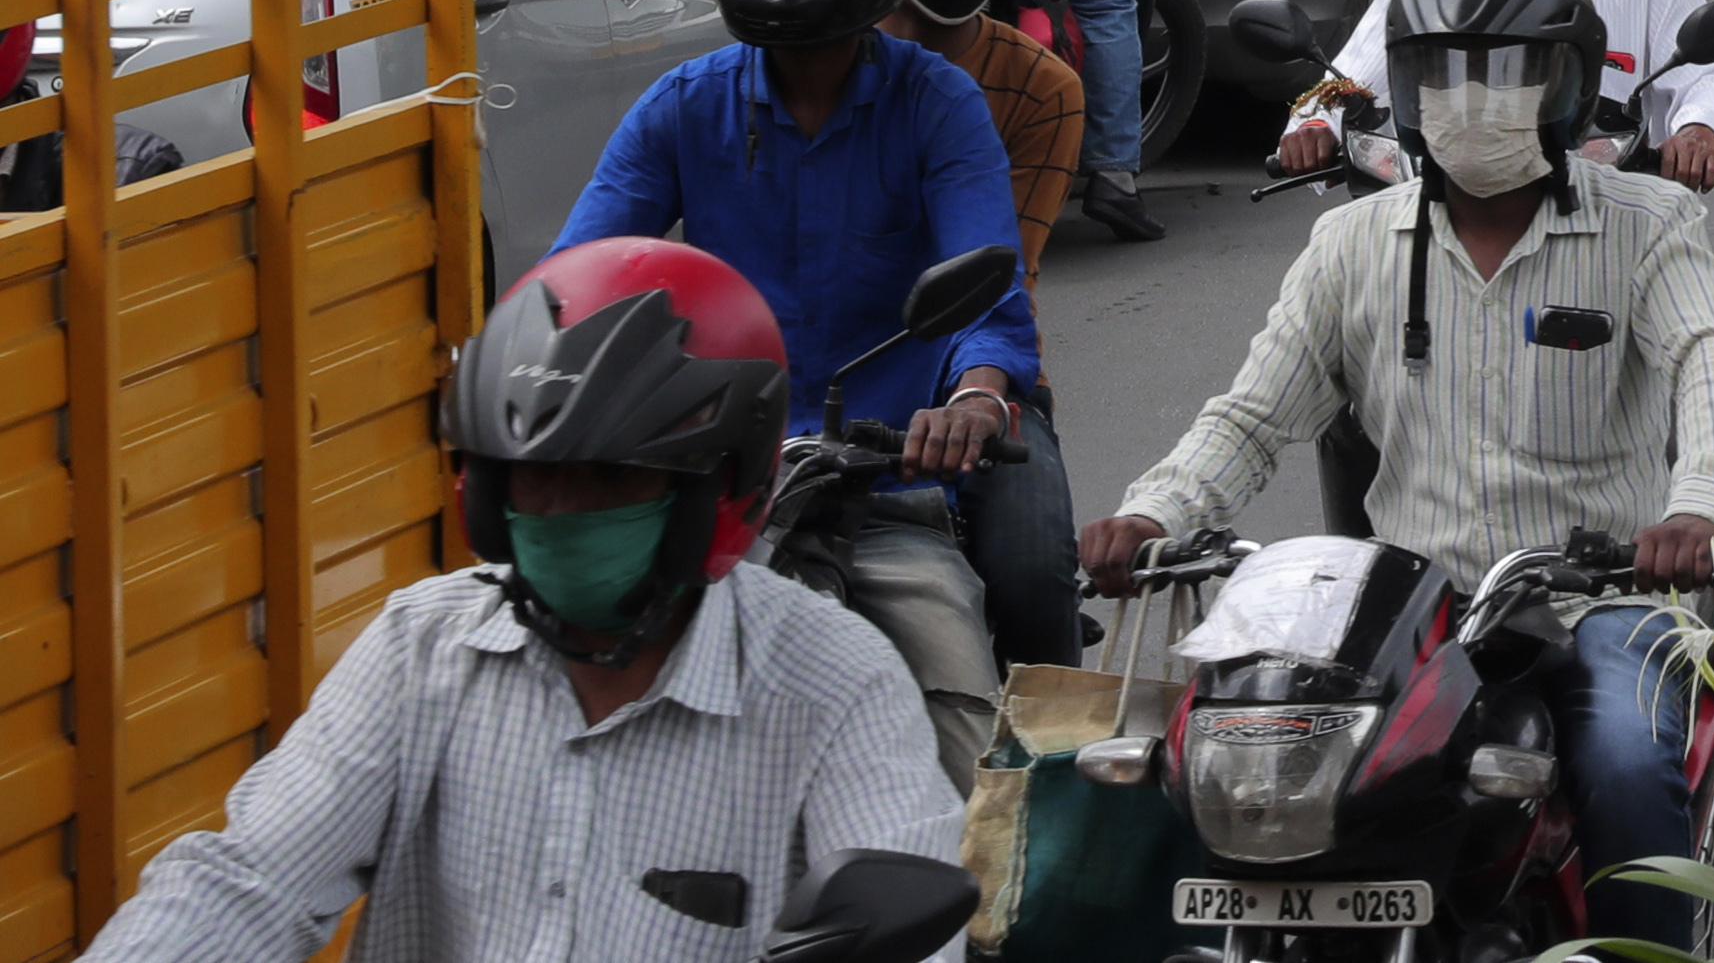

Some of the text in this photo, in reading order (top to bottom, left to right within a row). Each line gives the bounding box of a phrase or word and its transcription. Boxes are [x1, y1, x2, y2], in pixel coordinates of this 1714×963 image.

[152, 7, 194, 25] XE
[1184, 888, 1416, 922] AP28 AX 0263
